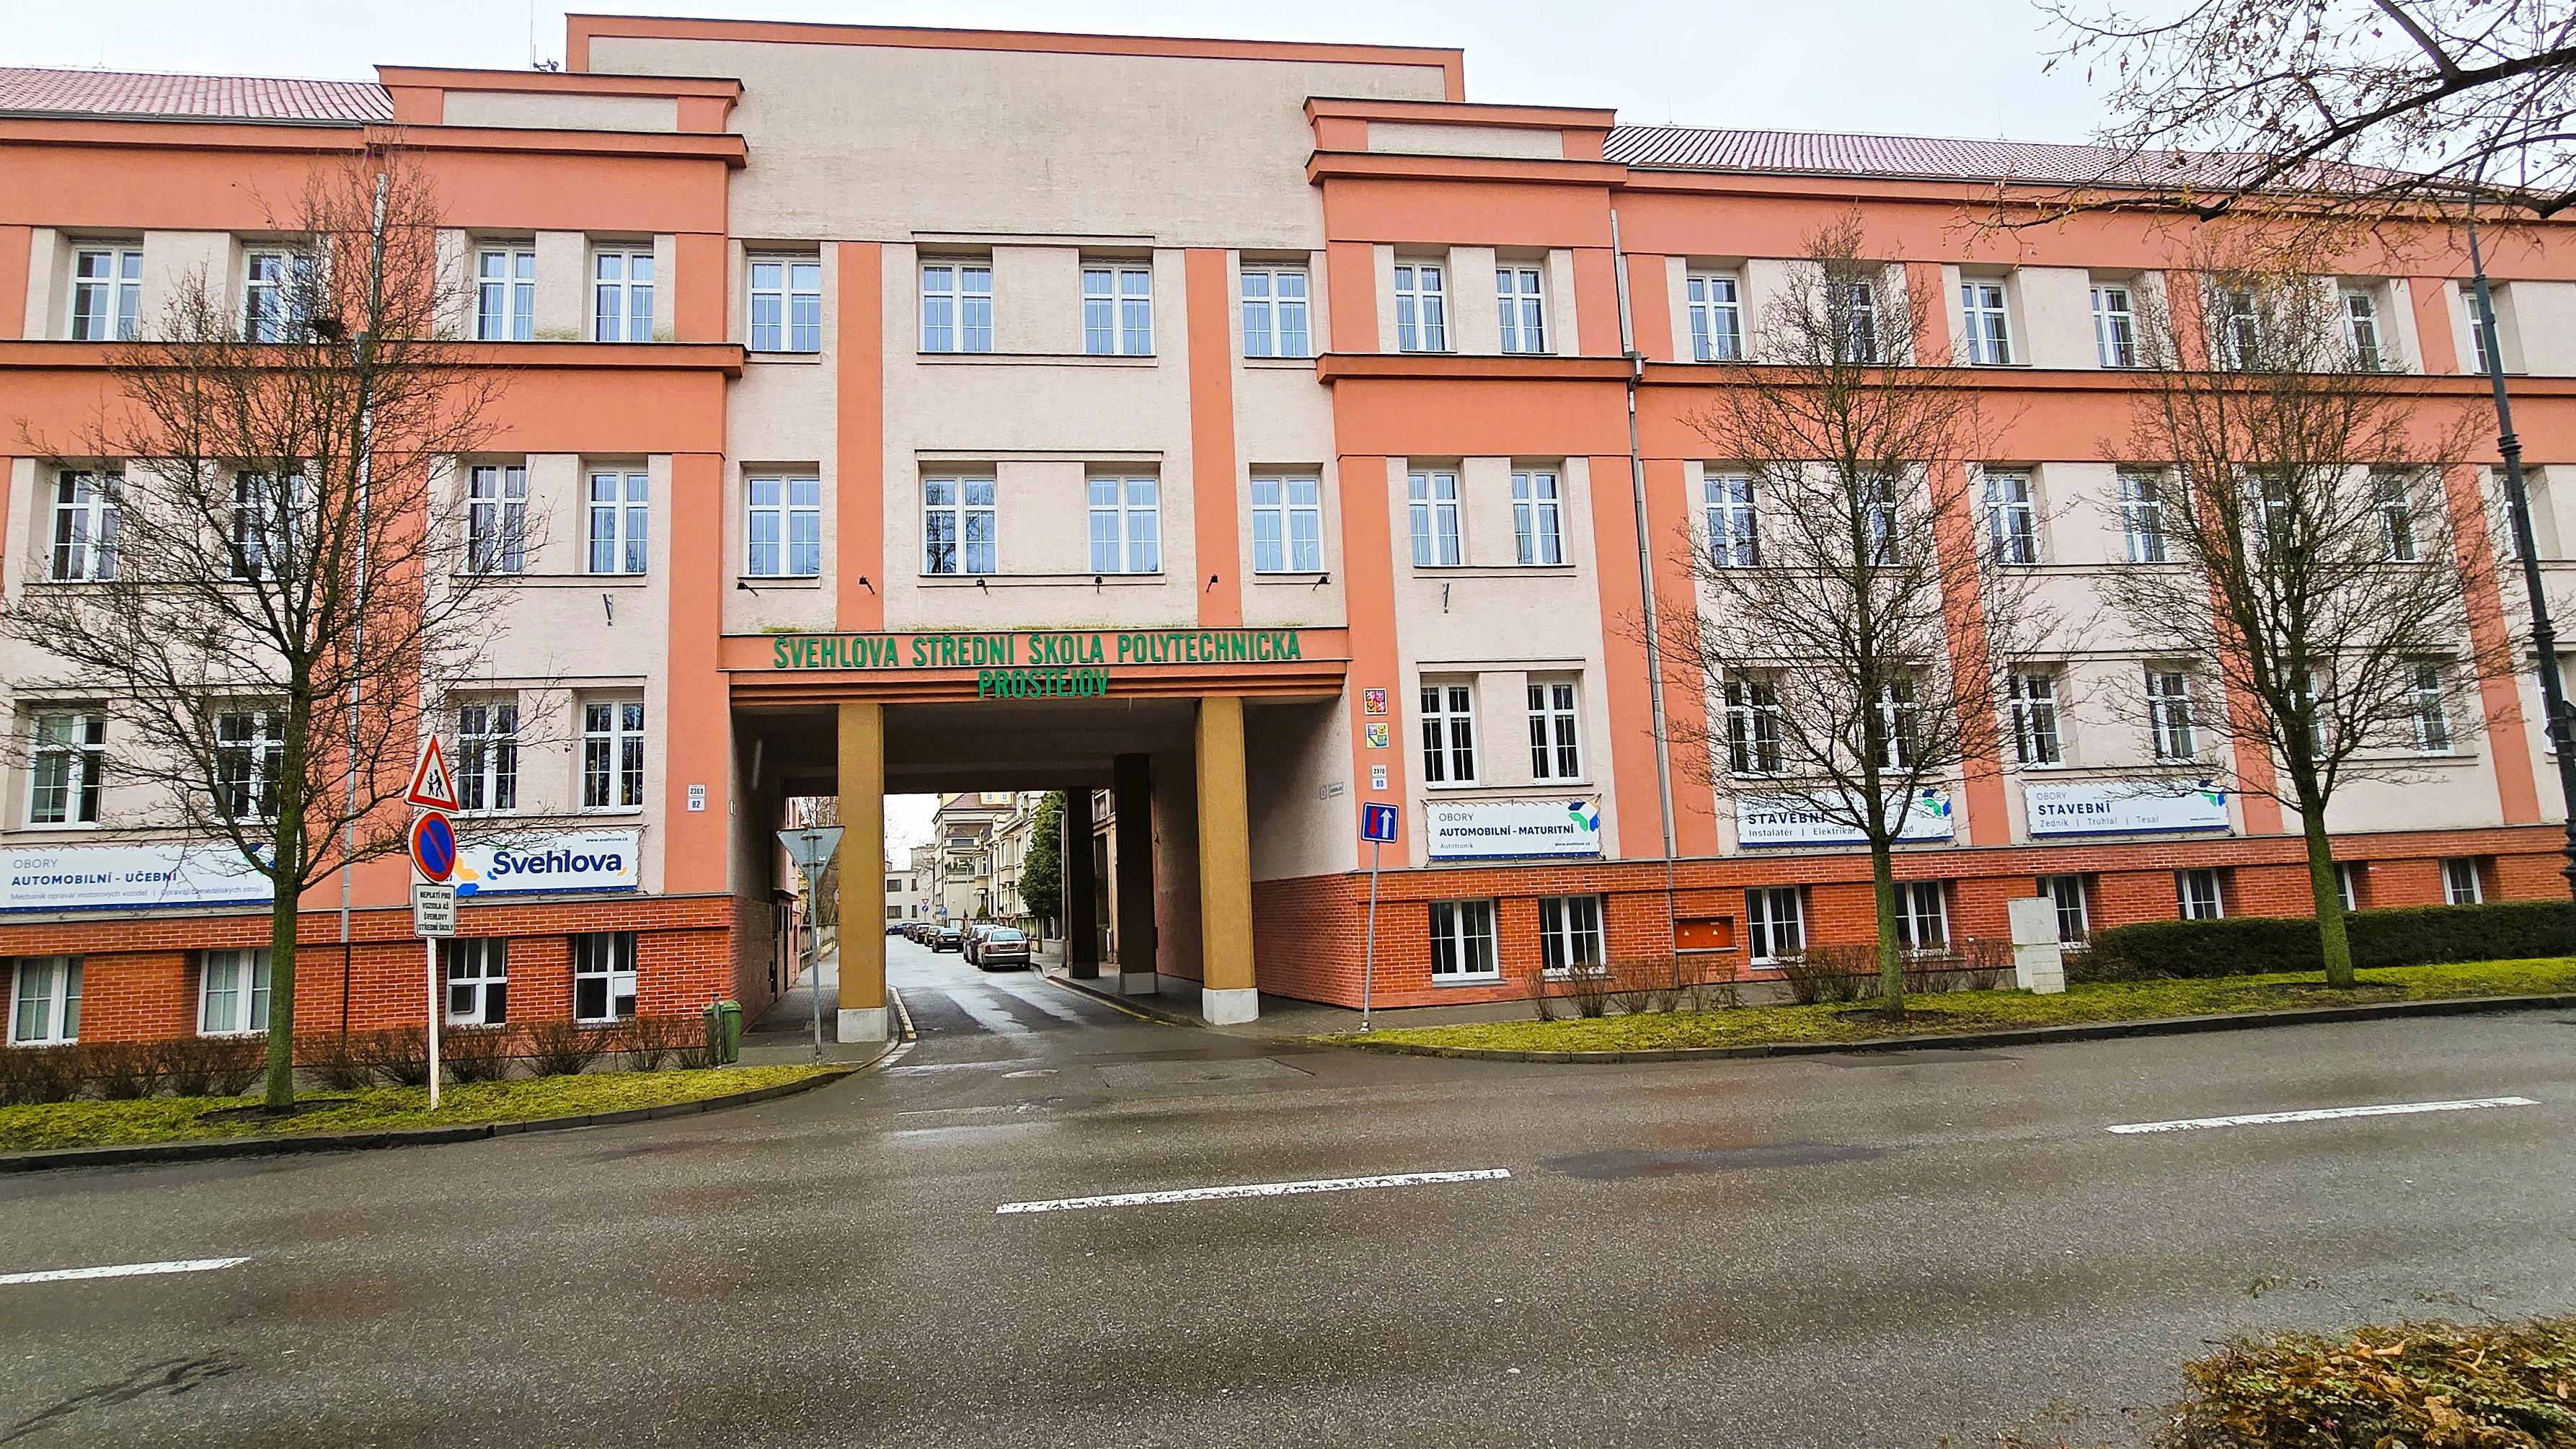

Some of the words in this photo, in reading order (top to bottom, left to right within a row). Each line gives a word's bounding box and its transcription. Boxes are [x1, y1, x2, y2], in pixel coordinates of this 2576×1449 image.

[774, 635, 899, 668] ŠVEHLOVA
[912, 634, 1014, 667] STŘEDNÍ
[1028, 633, 1105, 665] ŠKOLA
[1117, 630, 1302, 663] POLYTECHNICKÁ
[978, 667, 1110, 699] PROSTĚJOV
[2037, 792, 2067, 801] OBORY
[2038, 799, 2111, 815] STAVEBNÍ
[1439, 812, 1474, 822] OBORY
[1439, 825, 1511, 836] AUTOMOBILNÍ
[1519, 823, 1575, 835] MATURITNÍ
[13, 859, 58, 869] OBORY
[12, 872, 112, 886] AUTOMOBILNÍ
[125, 870, 177, 883] UČEBNÍ
